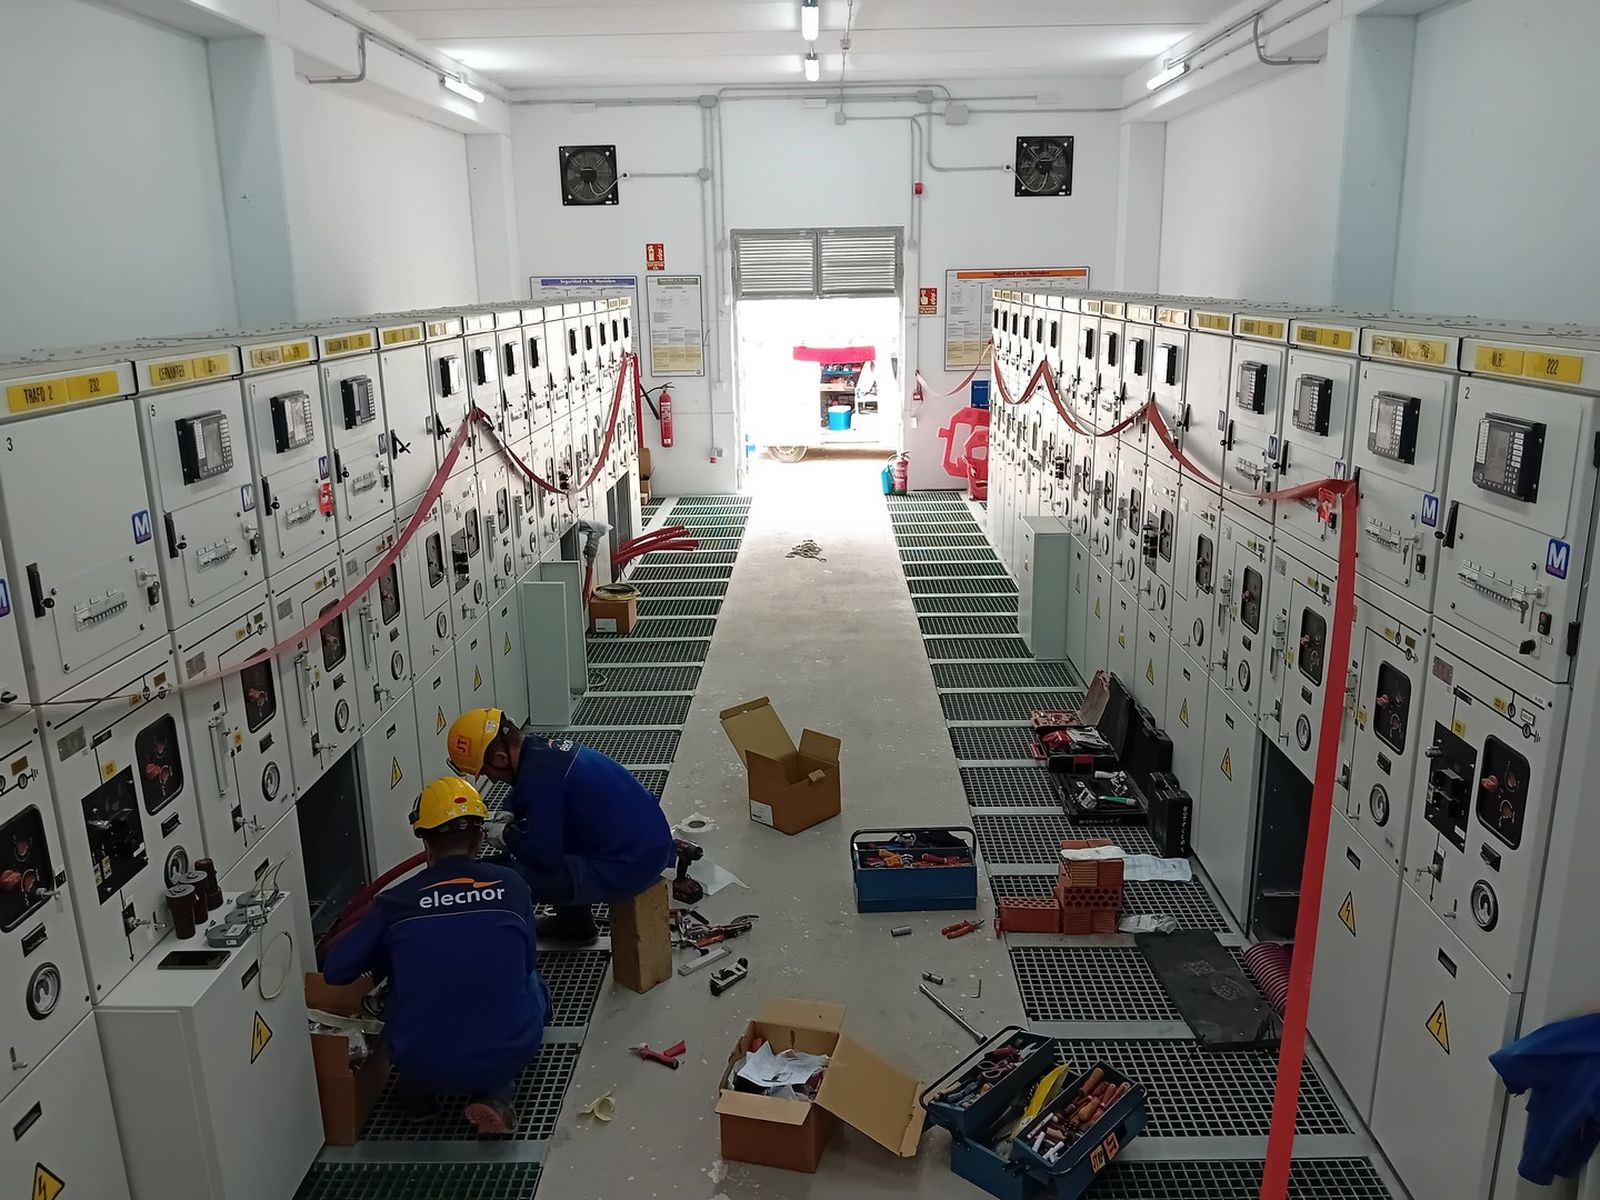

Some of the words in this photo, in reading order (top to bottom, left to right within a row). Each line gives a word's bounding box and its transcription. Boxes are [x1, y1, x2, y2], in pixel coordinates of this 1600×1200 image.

[1546, 358, 1560, 375] 222
[23, 386, 45, 405] TRAFO
[47, 384, 53, 401] 2
[1465, 386, 1471, 400] 2
[150, 404, 156, 417] 5
[6, 436, 13, 452] 3
[1424, 499, 1436, 521] M
[133, 512, 150, 538] M
[1548, 542, 1567, 571] M
[419, 888, 505, 909] elecnor
